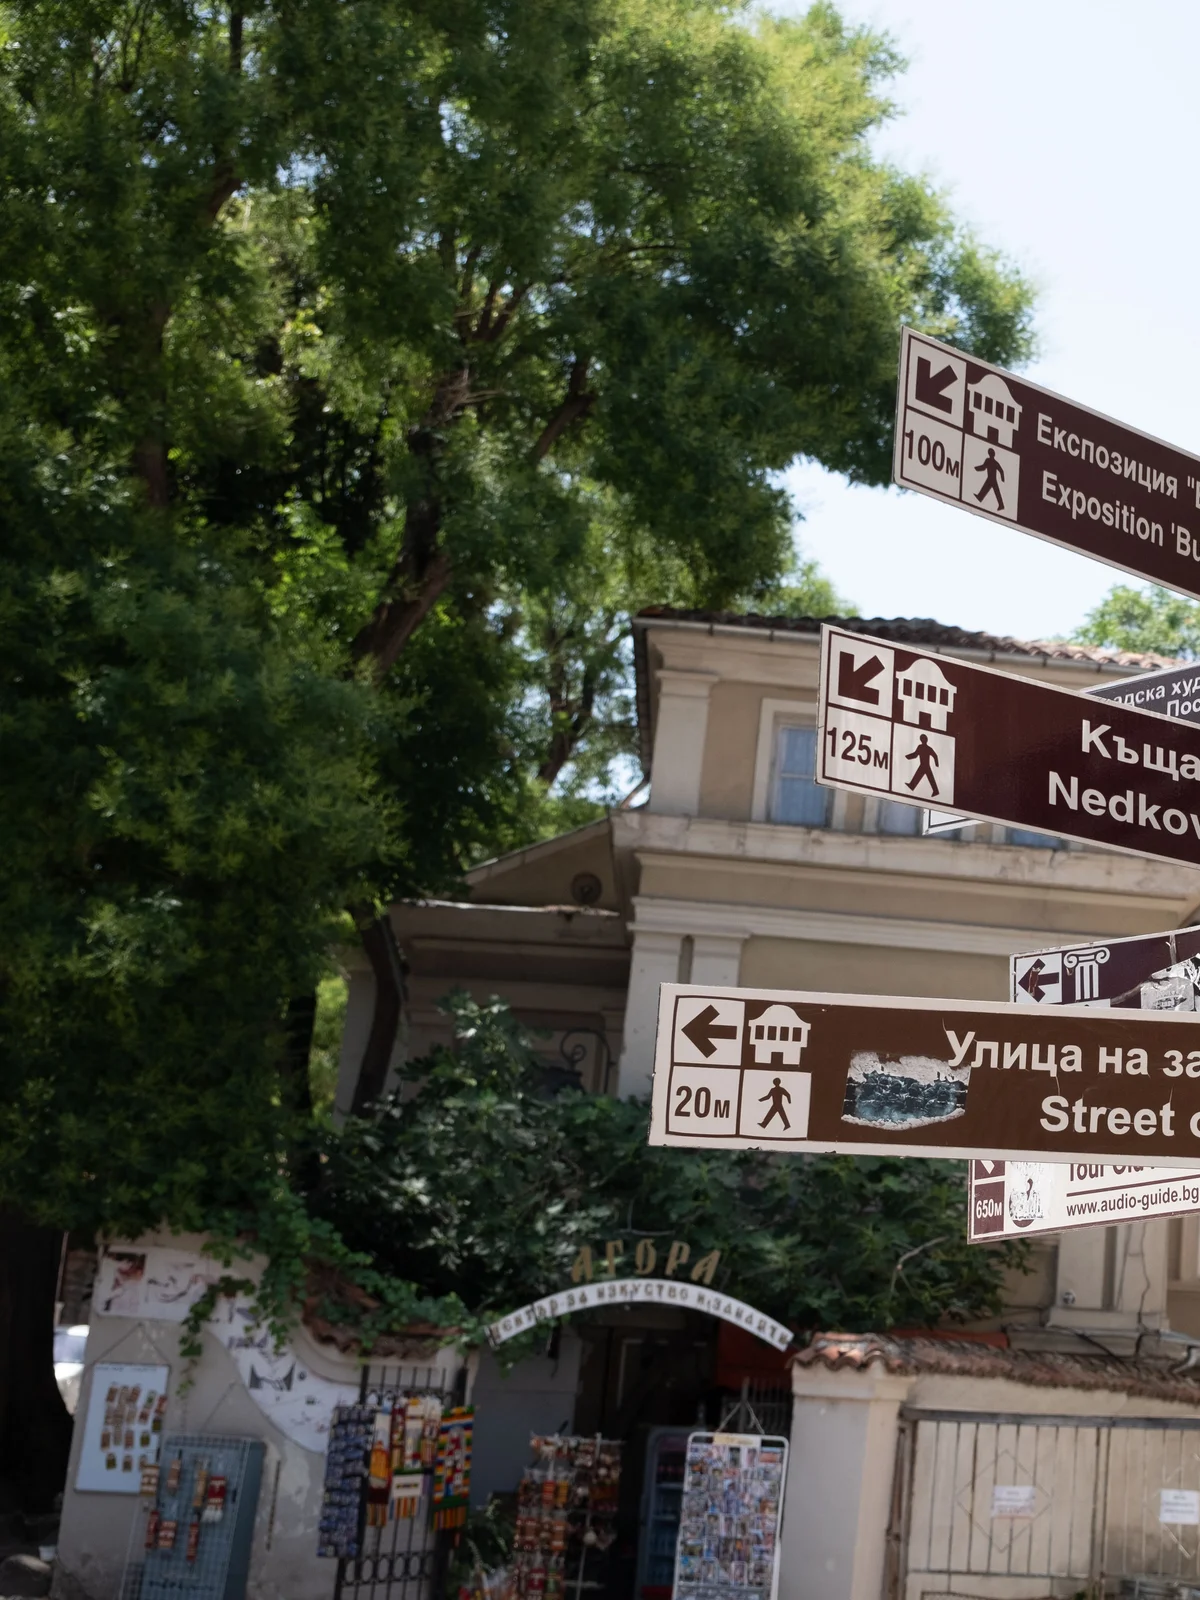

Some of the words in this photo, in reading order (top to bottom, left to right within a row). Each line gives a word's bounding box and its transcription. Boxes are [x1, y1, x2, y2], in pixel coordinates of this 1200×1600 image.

[1037, 412, 1178, 499] Експозиция
[1042, 470, 1164, 547] Exposition
[945, 1030, 1084, 1076] Улица
[1097, 1045, 1148, 1076] на
[1040, 1096, 1176, 1139] Street
[1066, 1185, 1200, 1217] www.audio-guide.bg
